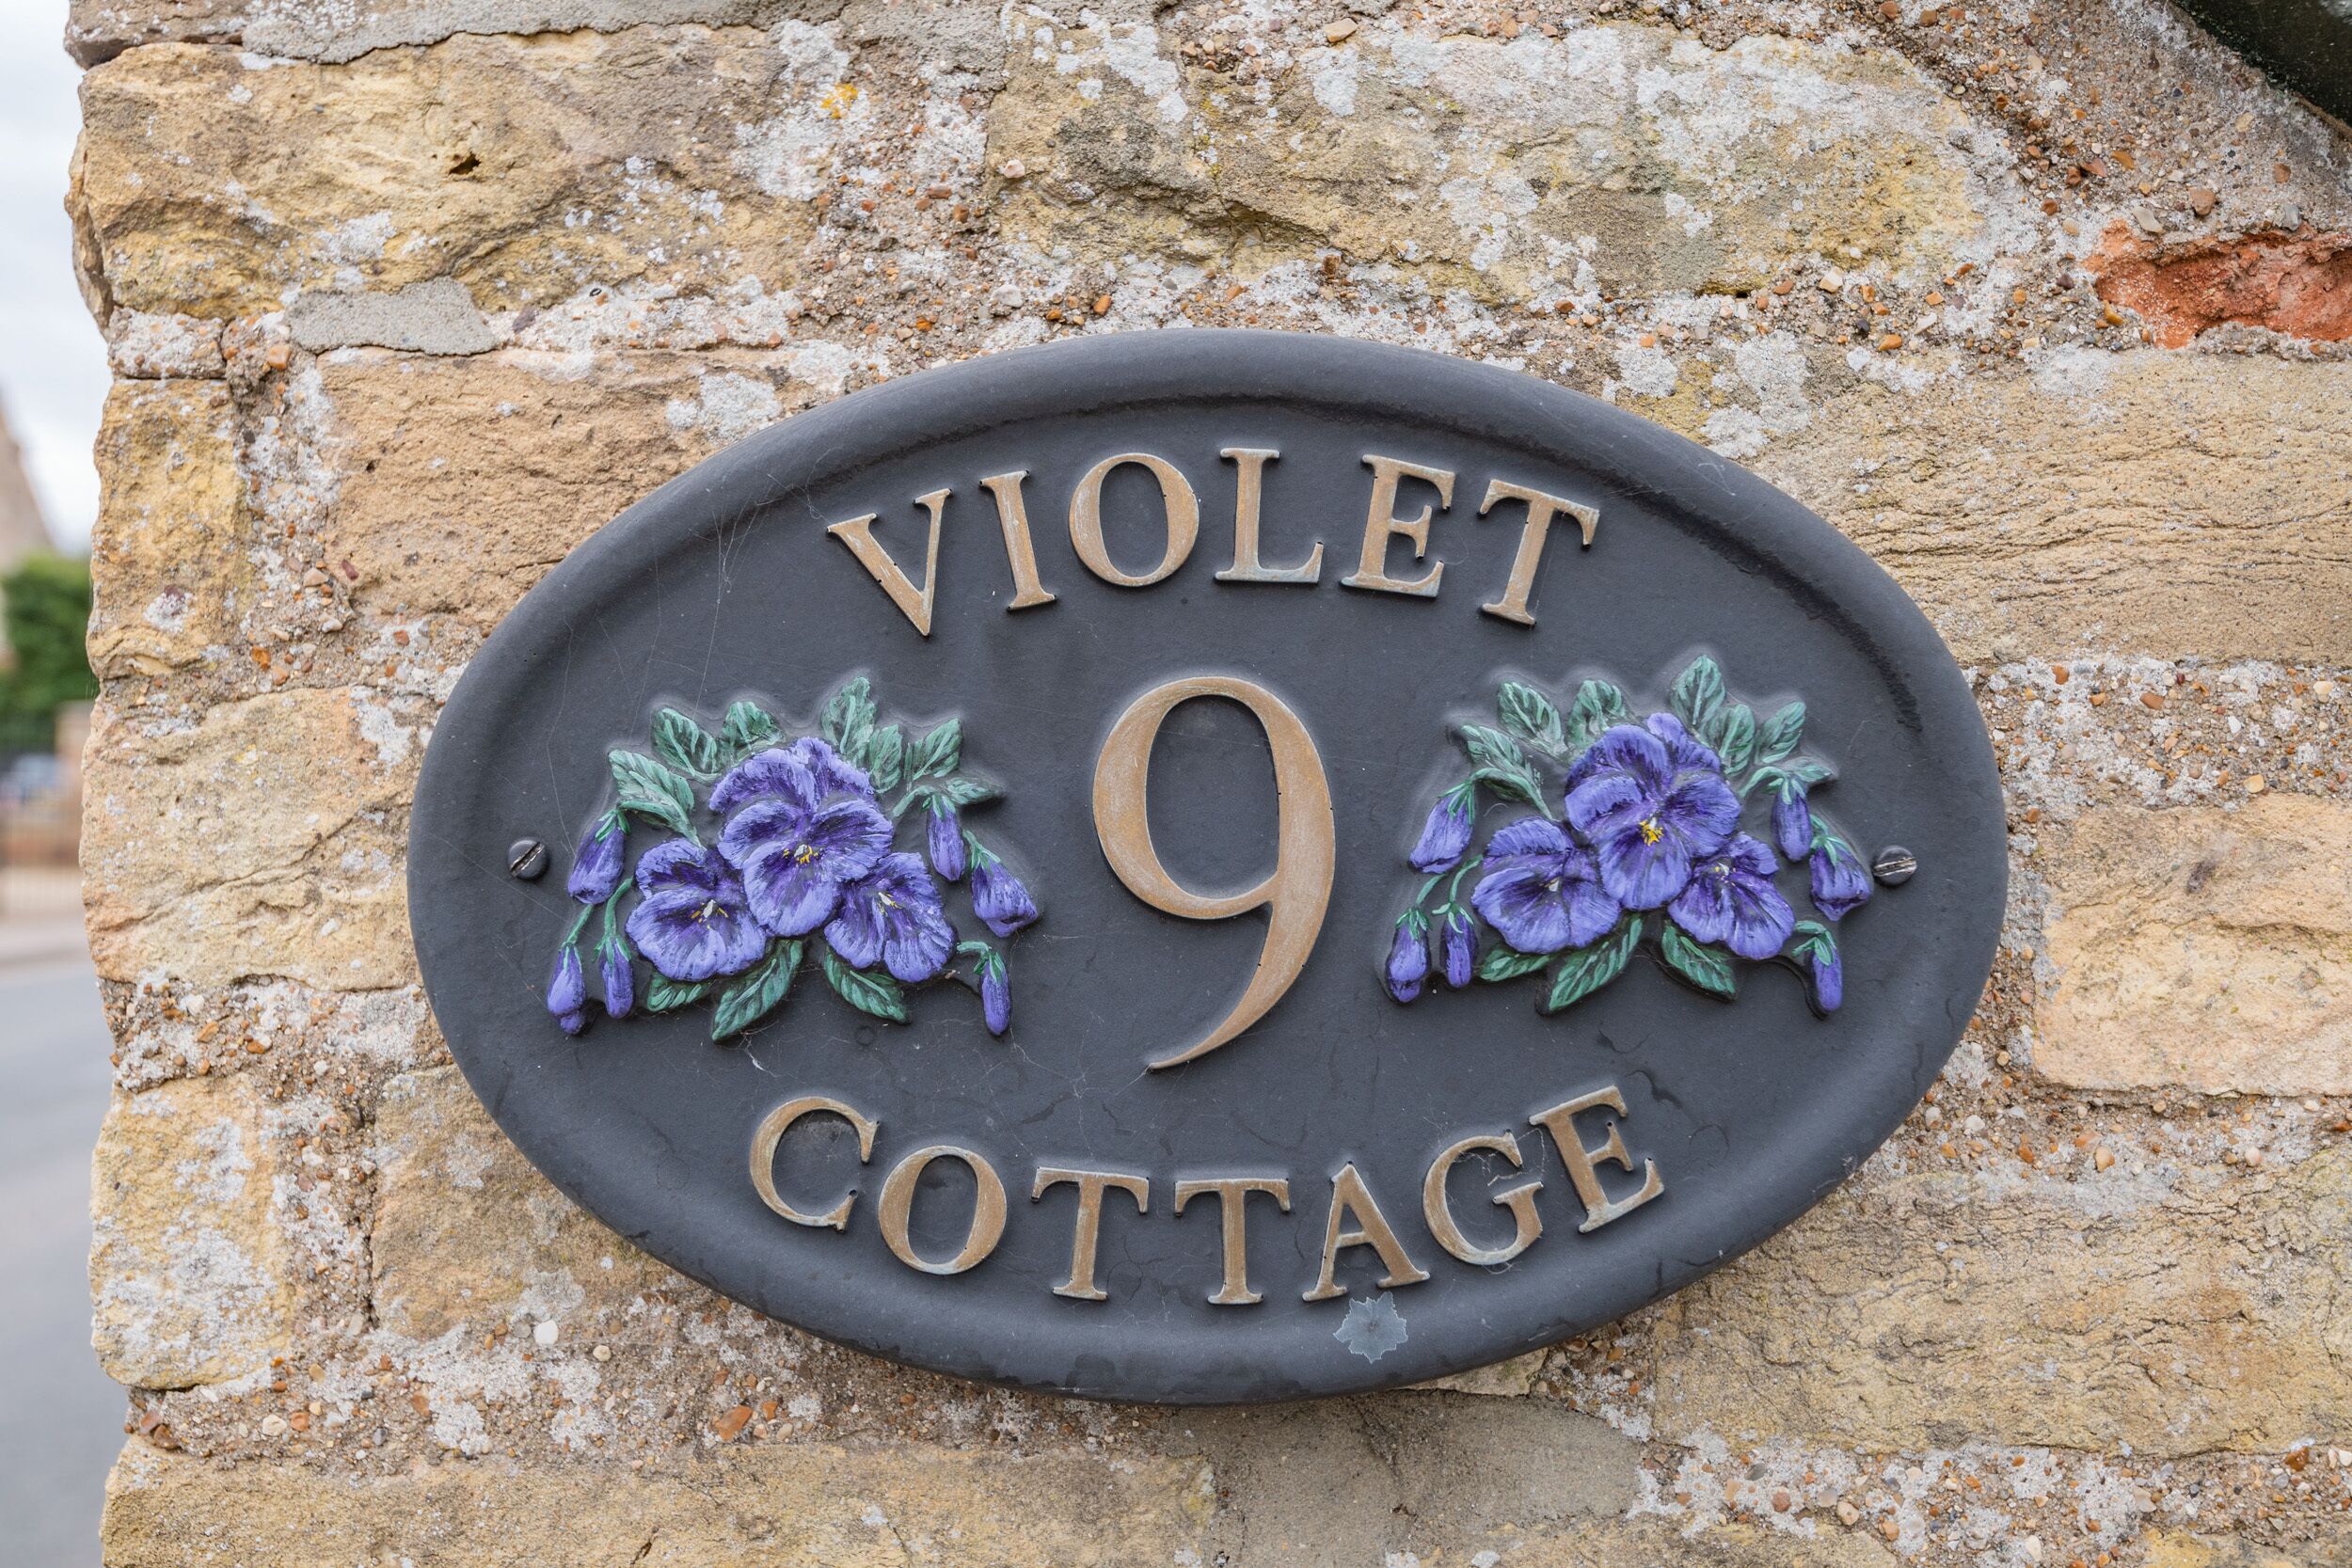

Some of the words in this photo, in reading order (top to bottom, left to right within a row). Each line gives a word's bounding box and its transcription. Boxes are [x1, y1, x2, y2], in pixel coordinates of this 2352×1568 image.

[827, 447, 1600, 636] VIOLET
[1092, 676, 1336, 1069] 9
[748, 1085, 1665, 1305] COTTAGE
